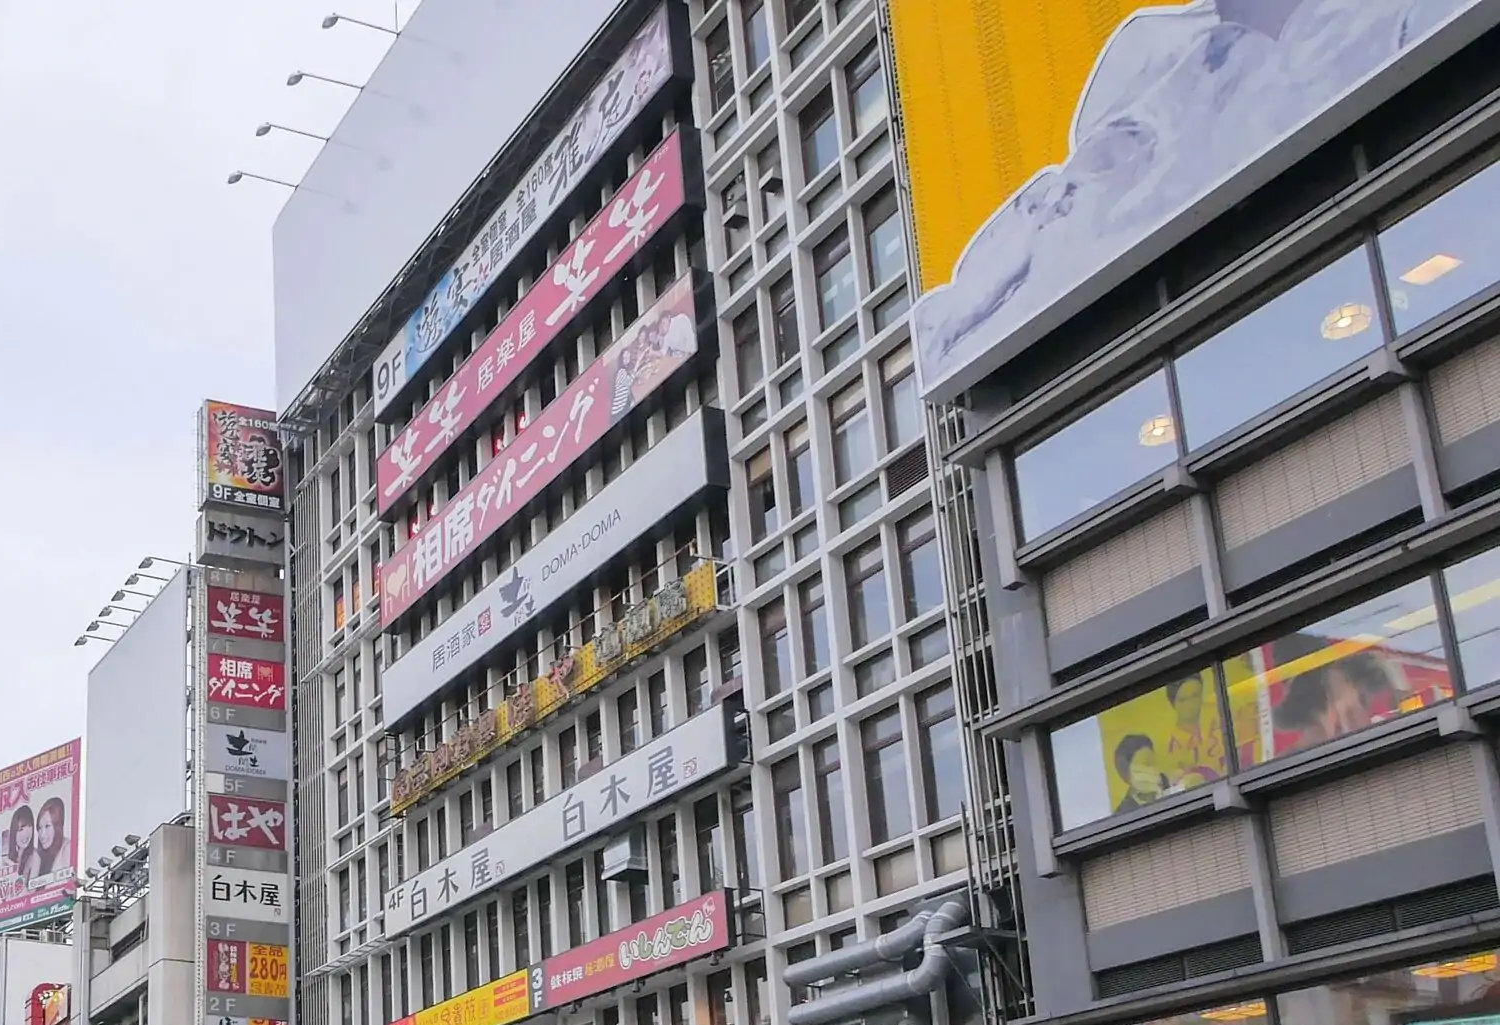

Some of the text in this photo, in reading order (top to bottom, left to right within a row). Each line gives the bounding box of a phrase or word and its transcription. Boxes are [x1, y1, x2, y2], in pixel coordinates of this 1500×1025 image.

[377, 350, 402, 400] 9F
[212, 483, 232, 500] 9F
[541, 507, 621, 582] DOMA-DOMA
[219, 658, 254, 680] 相席
[208, 676, 285, 705] ダイニング
[562, 745, 678, 842] 白木屋
[211, 874, 282, 907] 白木屋
[388, 847, 494, 921] 4F 白木屋
[250, 957, 287, 981] 280円
